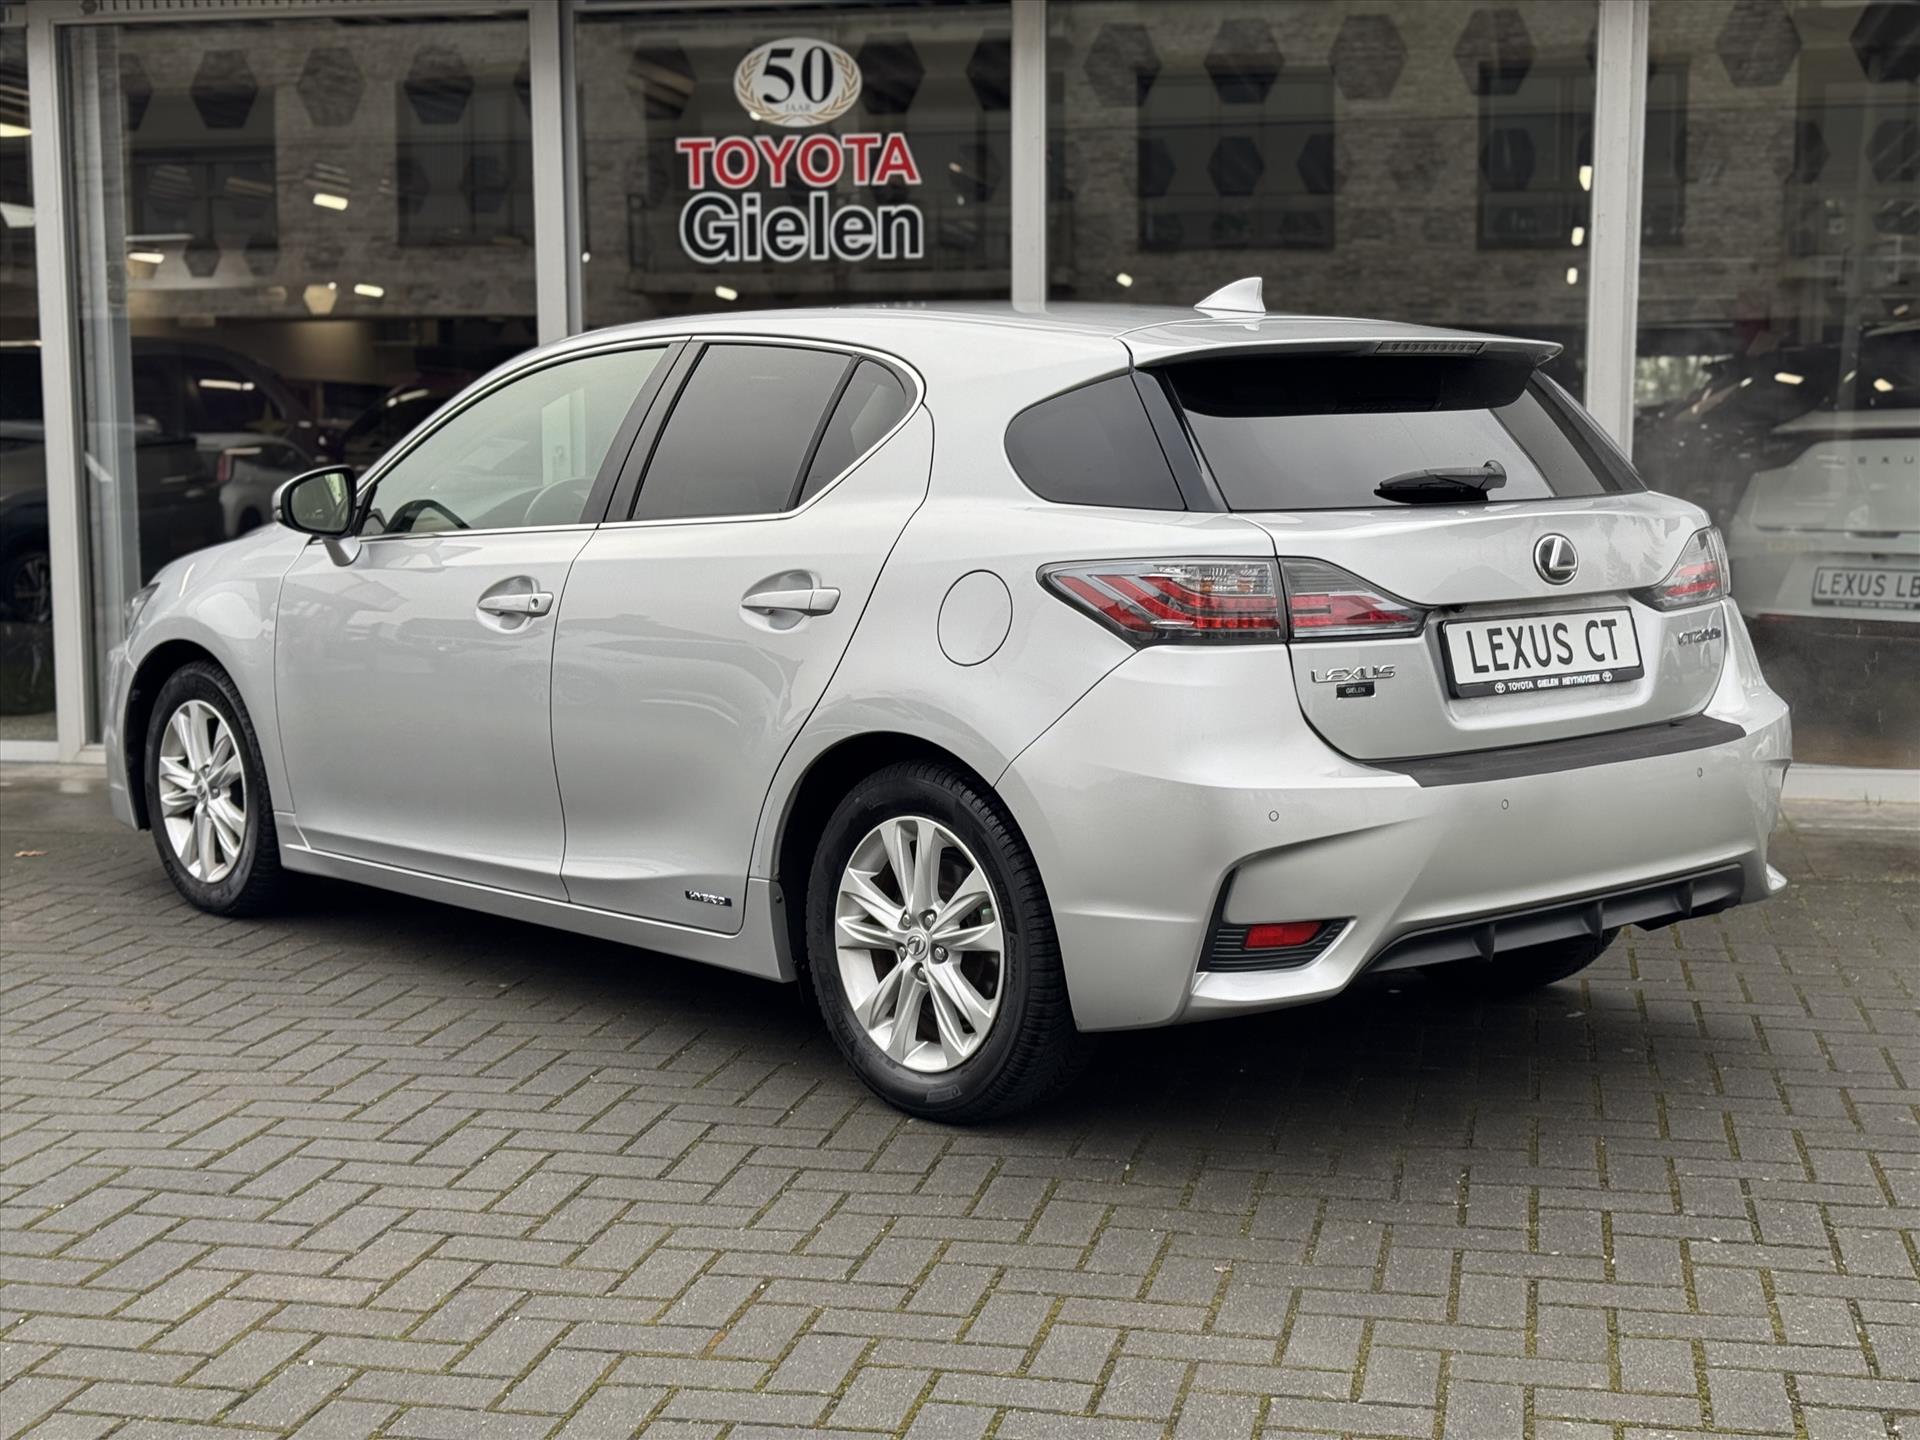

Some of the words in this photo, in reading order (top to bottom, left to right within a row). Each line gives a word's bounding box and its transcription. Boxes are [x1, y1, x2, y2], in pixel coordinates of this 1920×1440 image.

[763, 46, 834, 104] 50
[785, 103, 812, 113] JAAR
[676, 133, 922, 190] TOYOTA
[680, 191, 924, 263] Gielen
[1817, 572, 1887, 598] LEXUS
[1466, 622, 1574, 674] LEXUS
[1585, 618, 1618, 662] CT
[1311, 664, 1396, 683] LEXUS
[1507, 680, 1535, 692] TOYOTA
[1537, 677, 1559, 688] GIELEN
